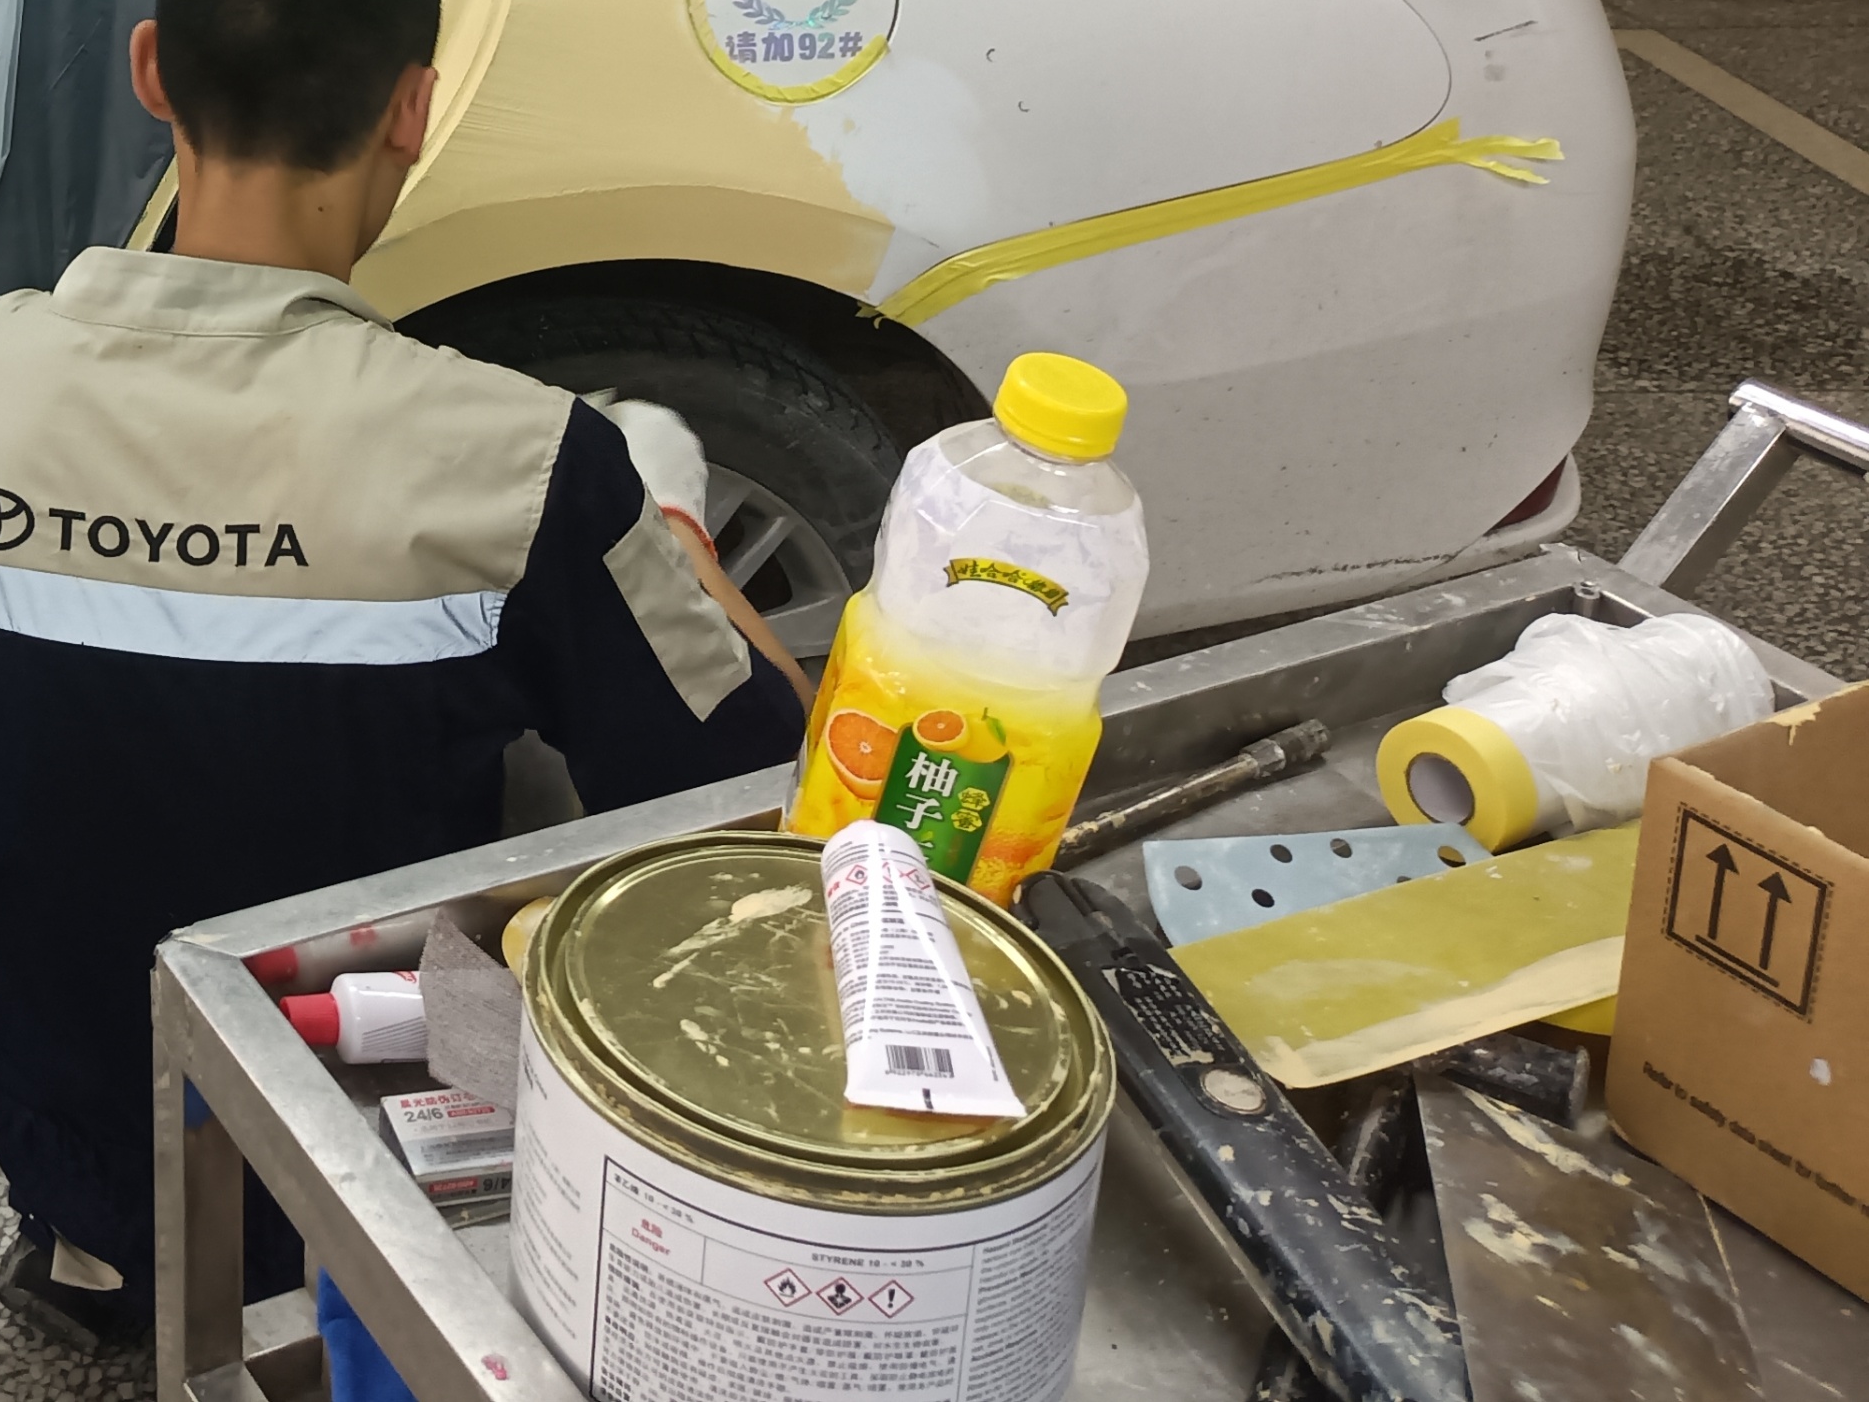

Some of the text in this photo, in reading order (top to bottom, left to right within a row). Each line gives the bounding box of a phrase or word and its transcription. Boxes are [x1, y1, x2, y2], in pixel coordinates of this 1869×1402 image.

[725, 31, 863, 64] 请加92#
[48, 507, 310, 568] TOYOTA
[403, 1107, 444, 1123] 24/6
[631, 1227, 671, 1256] Danger
[811, 1253, 865, 1267] STYRENE
